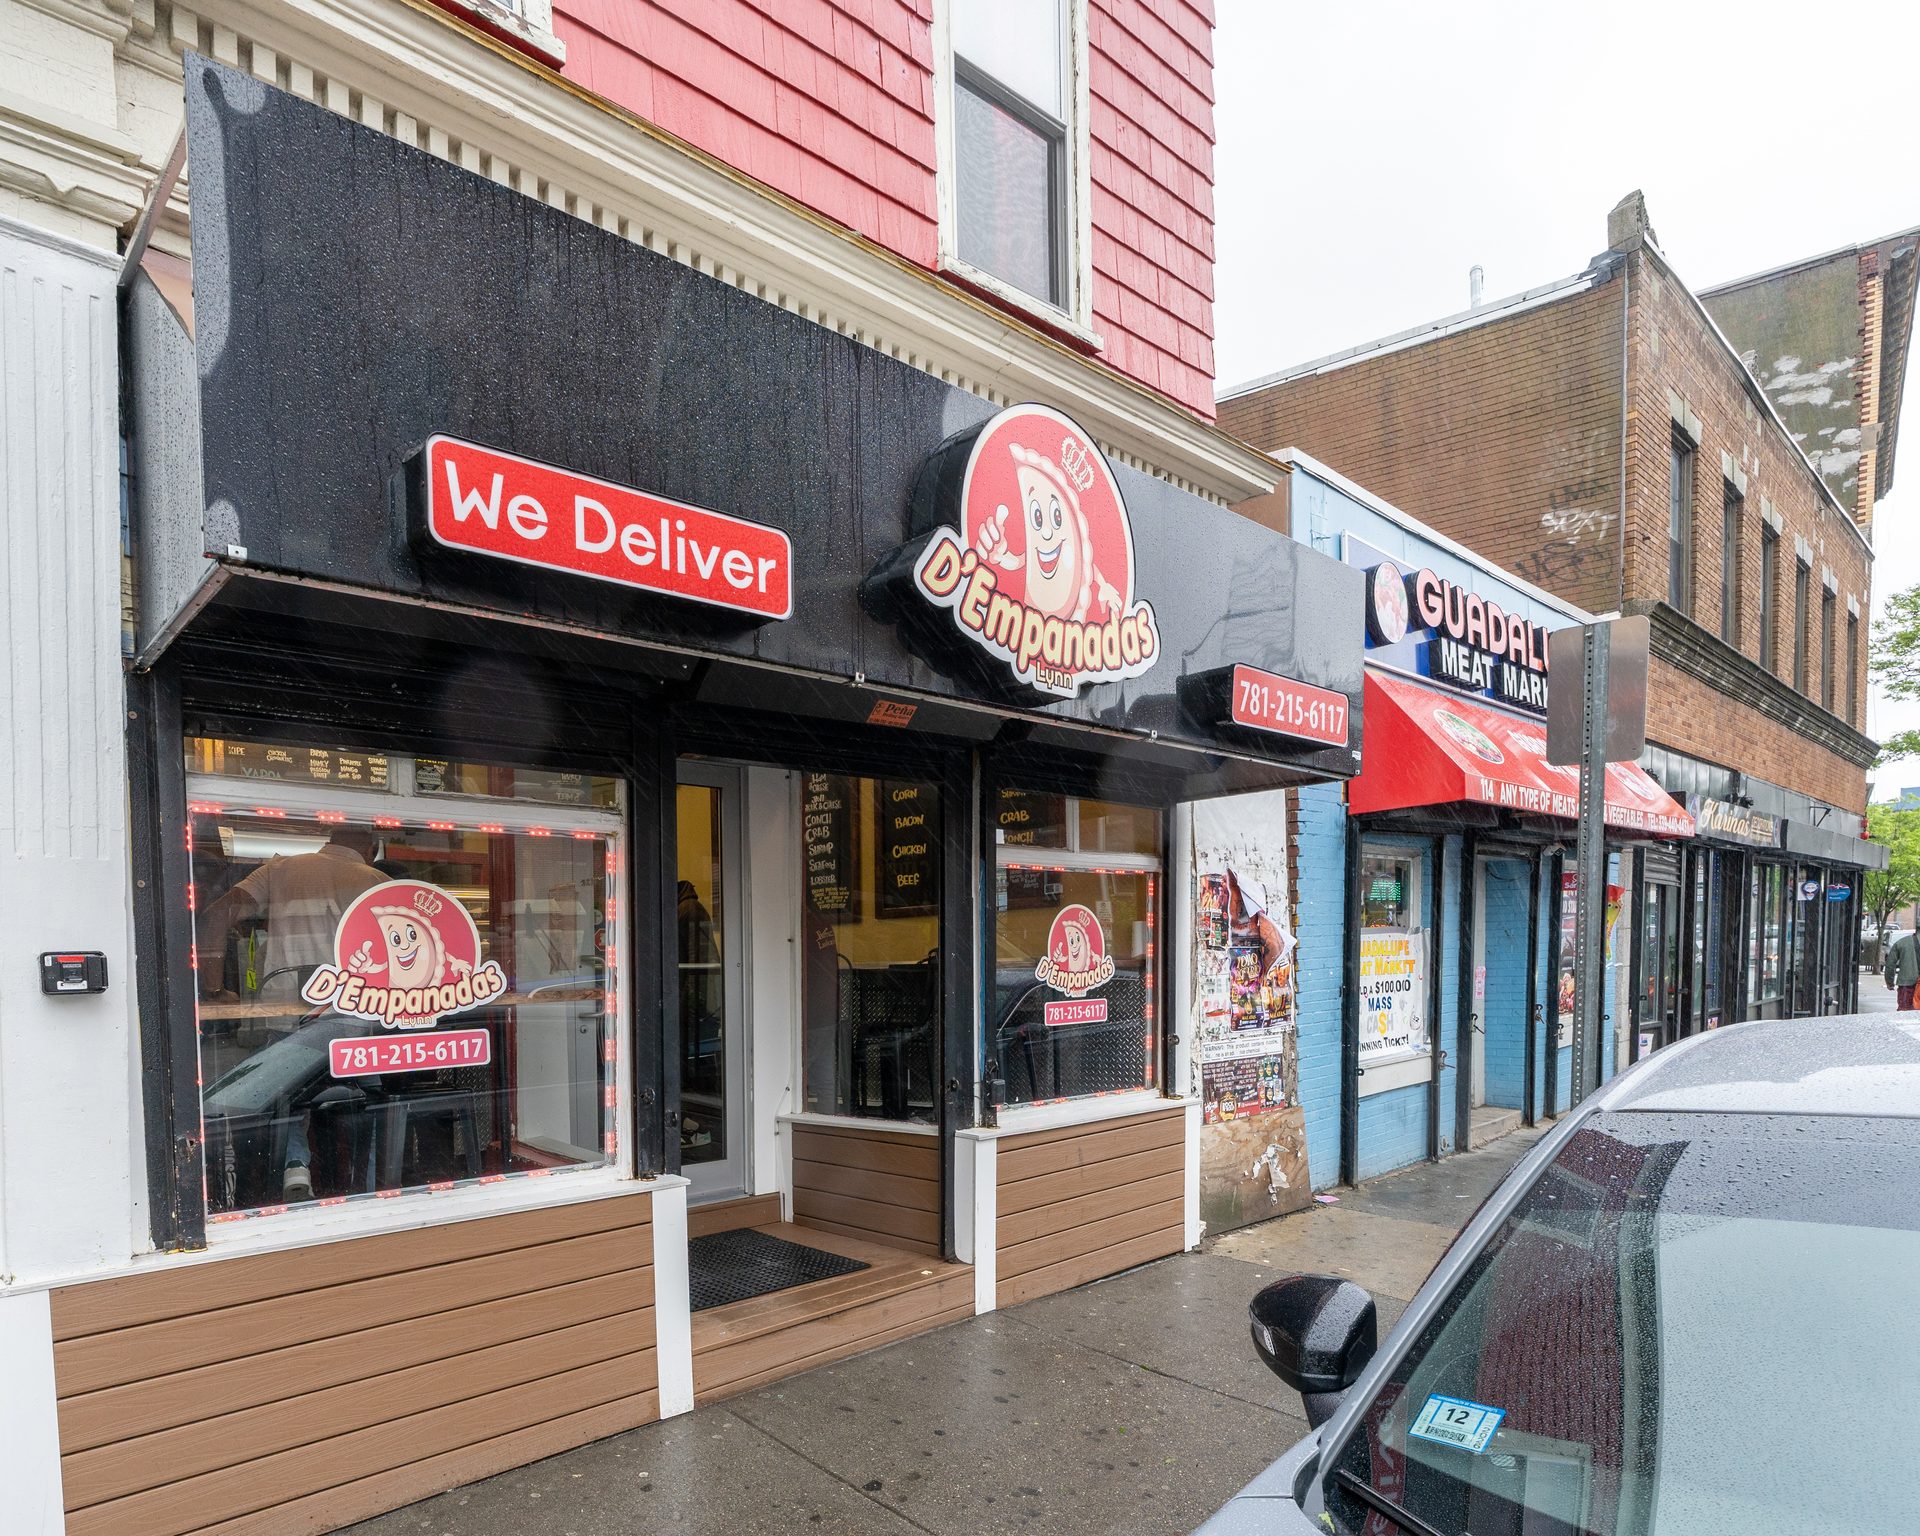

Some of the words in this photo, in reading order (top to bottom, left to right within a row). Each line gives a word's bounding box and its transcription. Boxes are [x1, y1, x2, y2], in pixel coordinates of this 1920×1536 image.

[444, 459, 548, 539] We
[575, 495, 777, 592] Deliver
[921, 537, 1154, 672] D'Empanadas
[1441, 638, 1493, 689] MEAT
[1036, 661, 1073, 690] Lynn
[1240, 680, 1344, 734] 781-215-6117
[892, 788, 917, 801] CORN
[1481, 778, 1494, 801] 114
[1500, 782, 1517, 805] ANY
[1519, 786, 1538, 810] TYPE
[1540, 791, 1551, 811] OF
[1552, 794, 1576, 816] MEATS
[1609, 804, 1643, 828] VEGETABLES
[805, 812, 832, 827] CONCH
[895, 814, 924, 829] BACON
[1000, 810, 1030, 824] CRAB
[1700, 797, 1750, 836] Karina's
[805, 826, 830, 842] CRAB
[1005, 832, 1033, 844] ONCH
[892, 843, 926, 859] CHICKEN
[810, 874, 836, 885] LOBSTER
[897, 873, 920, 887] BEEF
[1370, 880, 1401, 900] ATM
[1360, 940, 1409, 957] UADALUPE
[1037, 959, 1113, 994] D'Empanadas
[307, 966, 502, 1024] D'Empanadas
[1049, 1003, 1104, 1020] 781-215-6117
[1368, 996, 1392, 1012] MASS
[401, 1015, 432, 1027] Lynn
[340, 1038, 482, 1069] 781-215-6117
[1360, 1040, 1382, 1052] INNING
[1446, 1408, 1470, 1425] 12
